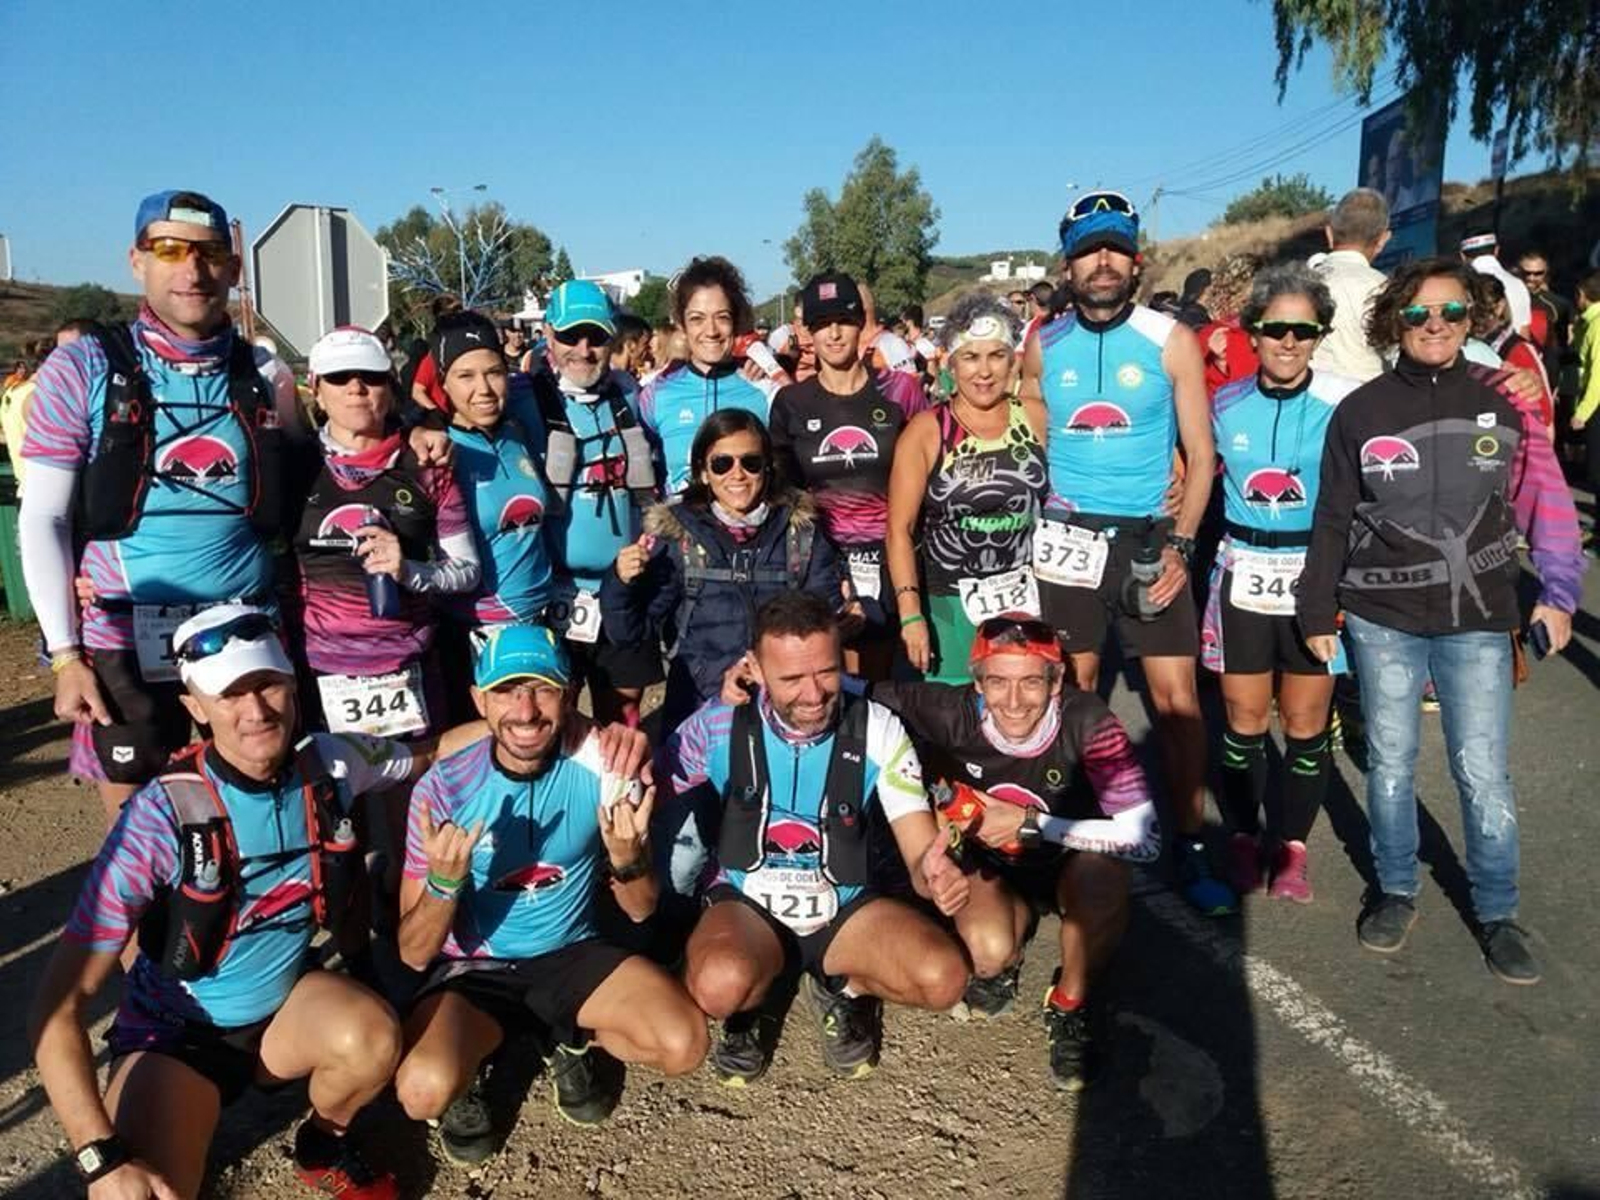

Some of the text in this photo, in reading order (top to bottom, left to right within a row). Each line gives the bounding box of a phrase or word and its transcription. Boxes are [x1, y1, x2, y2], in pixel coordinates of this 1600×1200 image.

[1039, 541, 1091, 571] 373
[1363, 568, 1432, 584] CLUB
[978, 585, 1028, 614] 118
[342, 690, 409, 722] 344
[760, 892, 823, 918] 121
